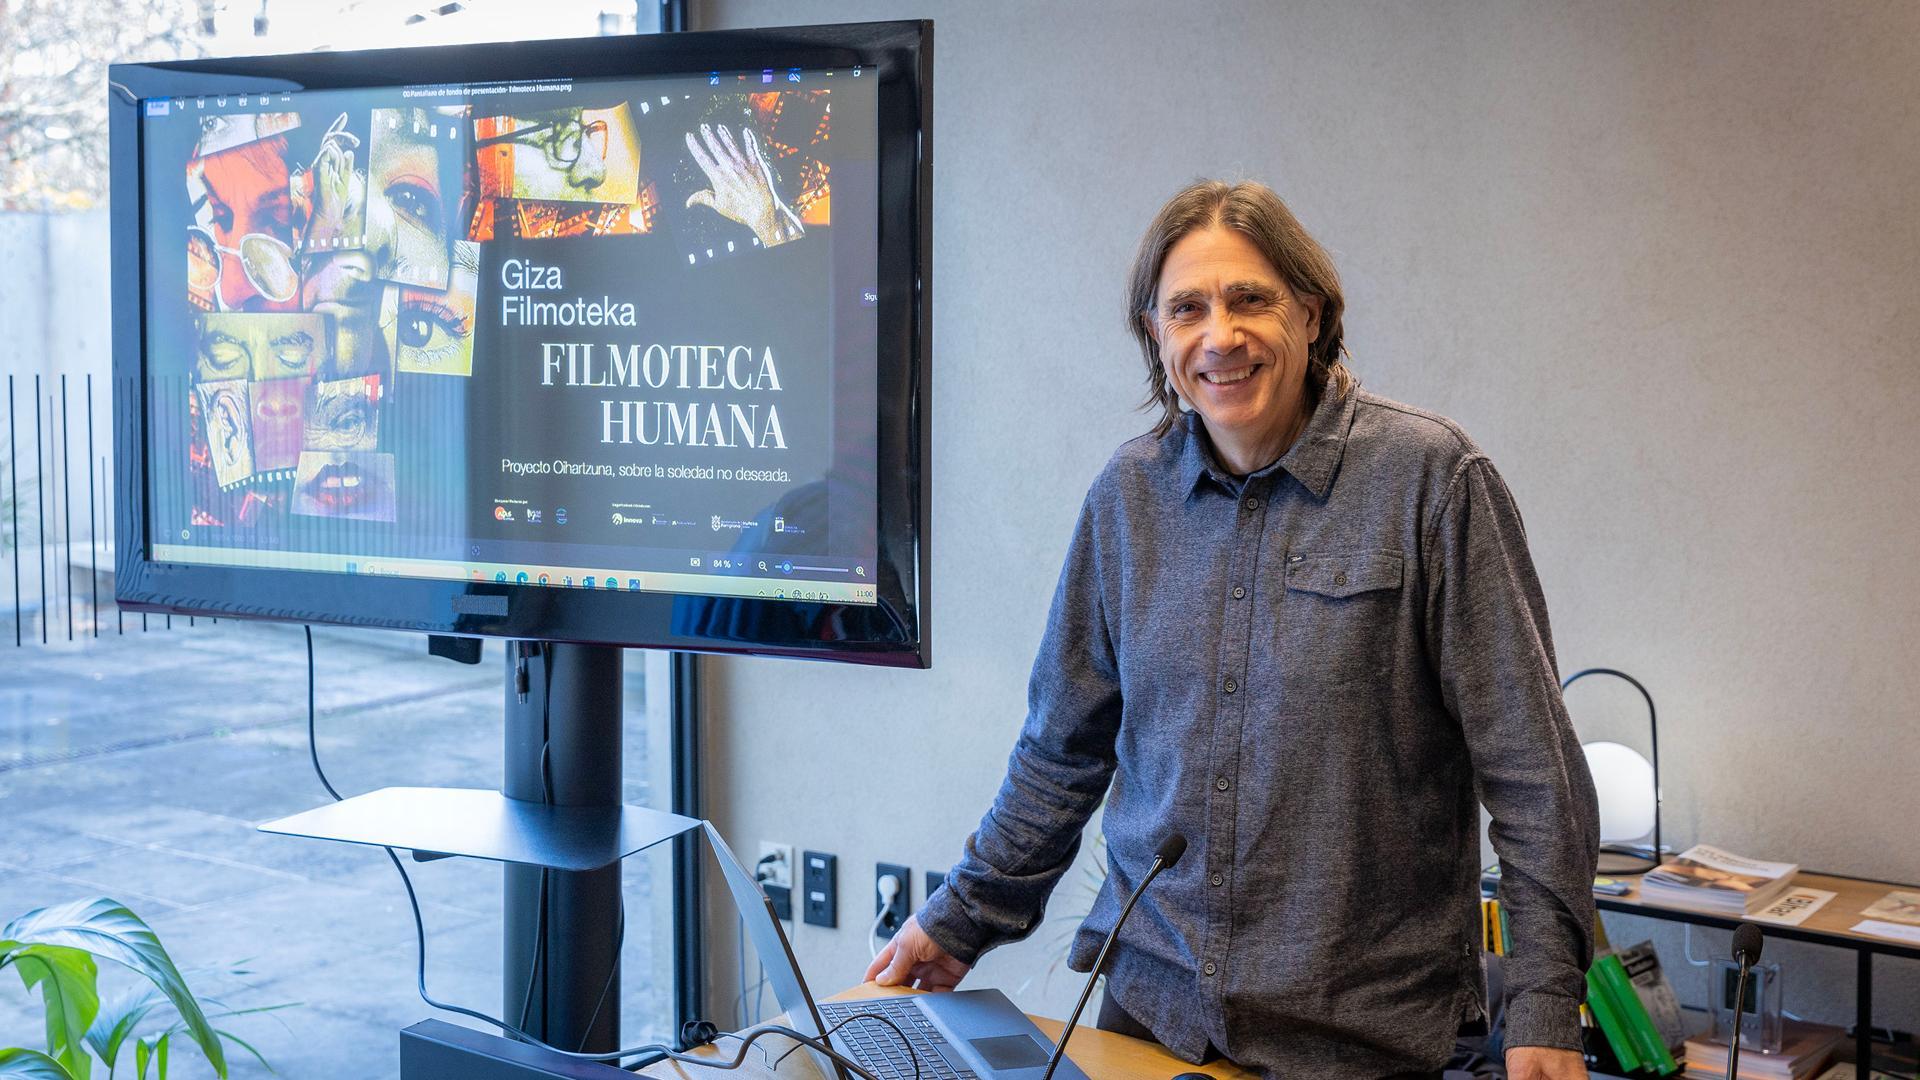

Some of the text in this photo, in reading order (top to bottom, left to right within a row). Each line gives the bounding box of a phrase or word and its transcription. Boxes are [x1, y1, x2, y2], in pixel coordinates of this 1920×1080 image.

[501, 259, 562, 290] Giza
[502, 296, 637, 327] Filmoteka
[541, 343, 783, 391] FILMOTECA
[600, 400, 788, 449] HUMANA
[502, 459, 791, 482] Proyecto Oihartzuna, sobre la soledad no deseada.
